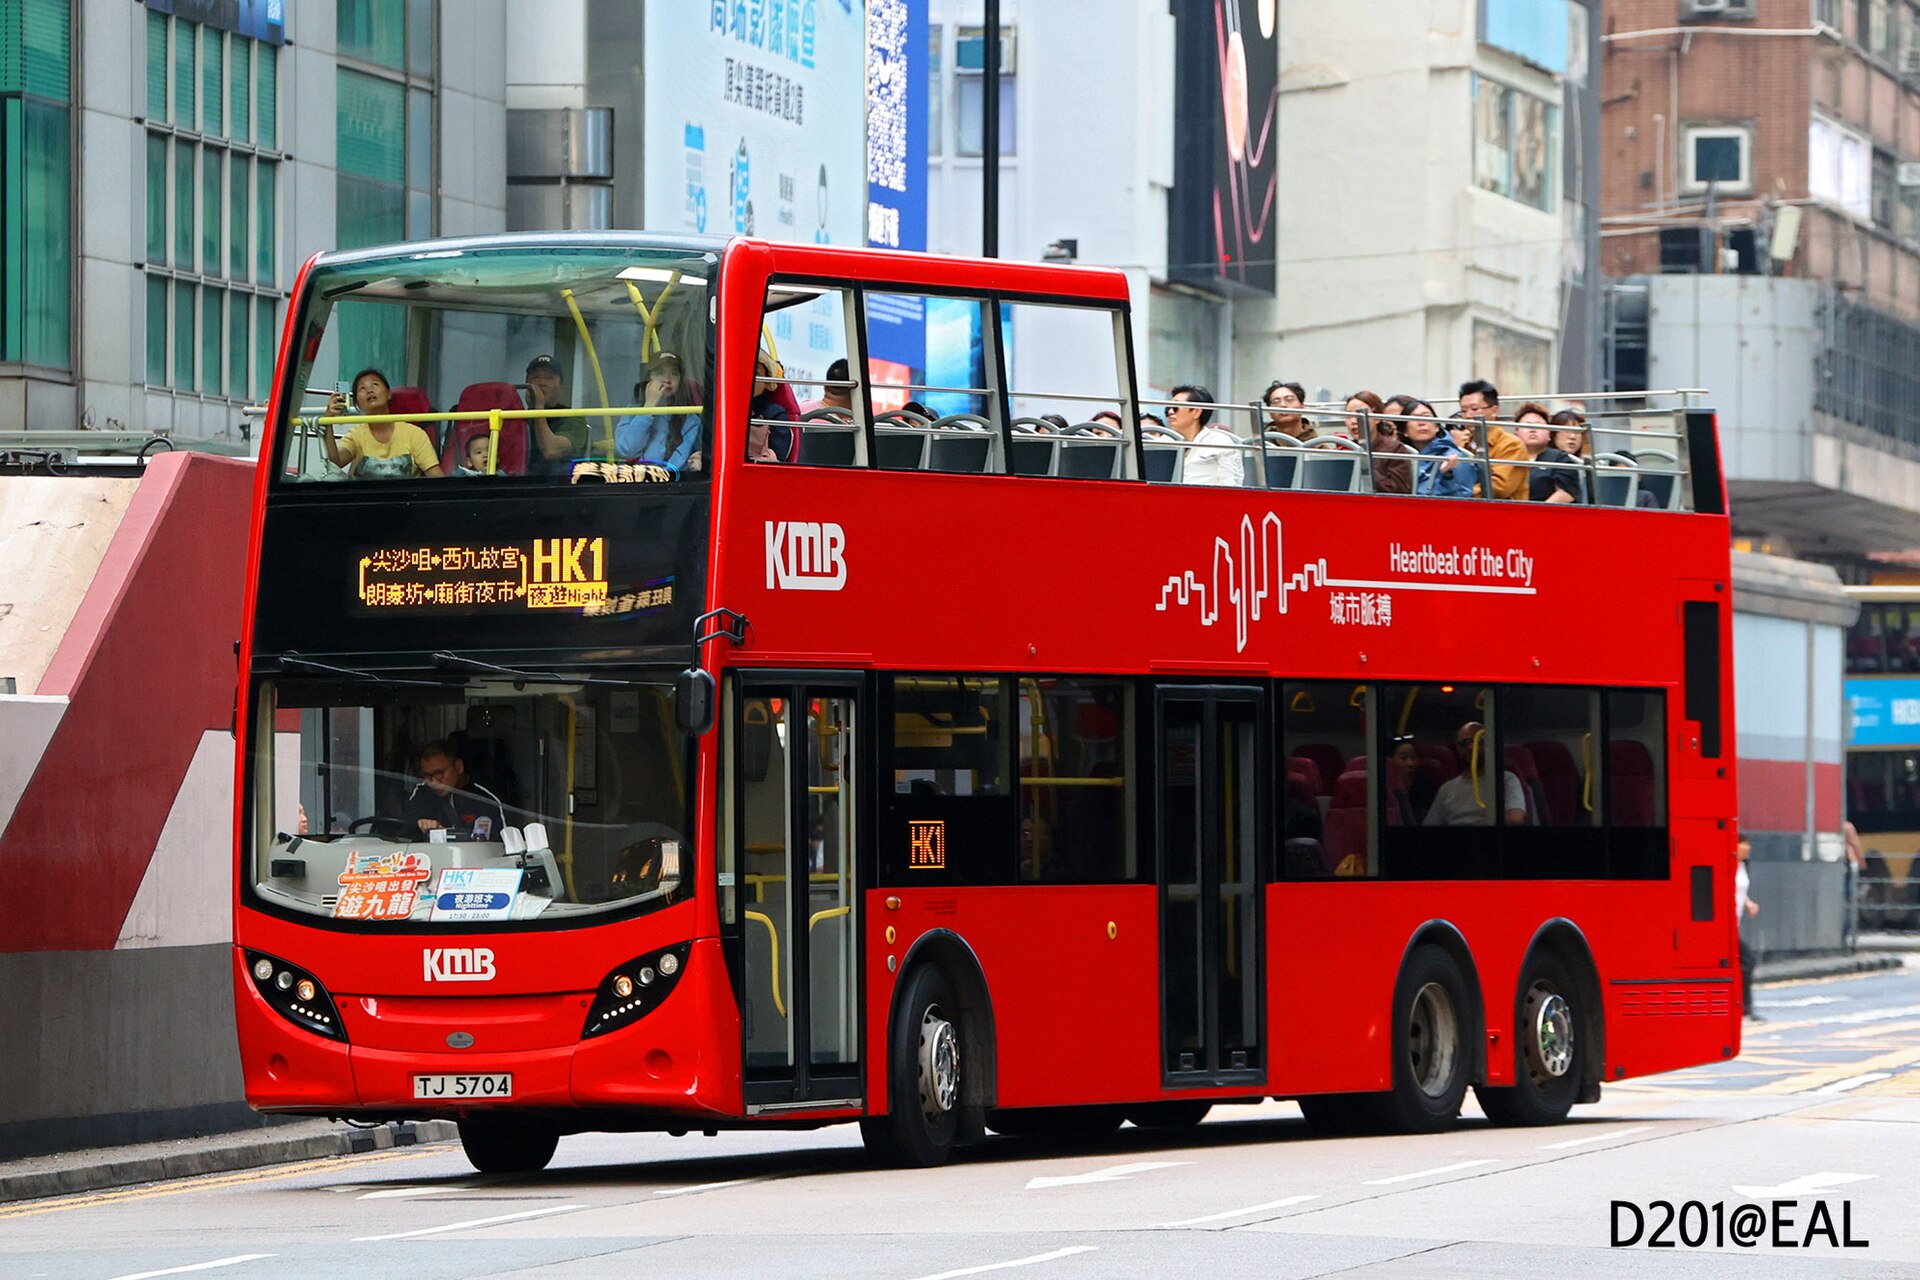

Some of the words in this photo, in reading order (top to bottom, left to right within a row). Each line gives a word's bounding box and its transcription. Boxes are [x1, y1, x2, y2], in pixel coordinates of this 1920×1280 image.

[372, 548, 432, 572] 尖沙咀
[442, 546, 520, 571] 西九故宮
[533, 537, 604, 582] HK1
[765, 521, 847, 591] KMB
[1390, 542, 1460, 575] Heartbeat
[1462, 546, 1478, 576] of
[1480, 547, 1504, 577] the
[1506, 548, 1534, 587] City
[366, 581, 425, 606] 朗豪坊
[432, 579, 516, 604] 廟街夜市
[1329, 592, 1393, 627] 城市脈搏
[911, 826, 941, 864] HK1
[349, 879, 414, 894] 尖沙咀出發
[443, 870, 474, 884] HK1
[338, 892, 414, 917] 遊九龍
[455, 902, 489, 910] Nighttime
[423, 948, 496, 982] KMB
[418, 1077, 445, 1096] TJ
[455, 1076, 509, 1095] 5704
